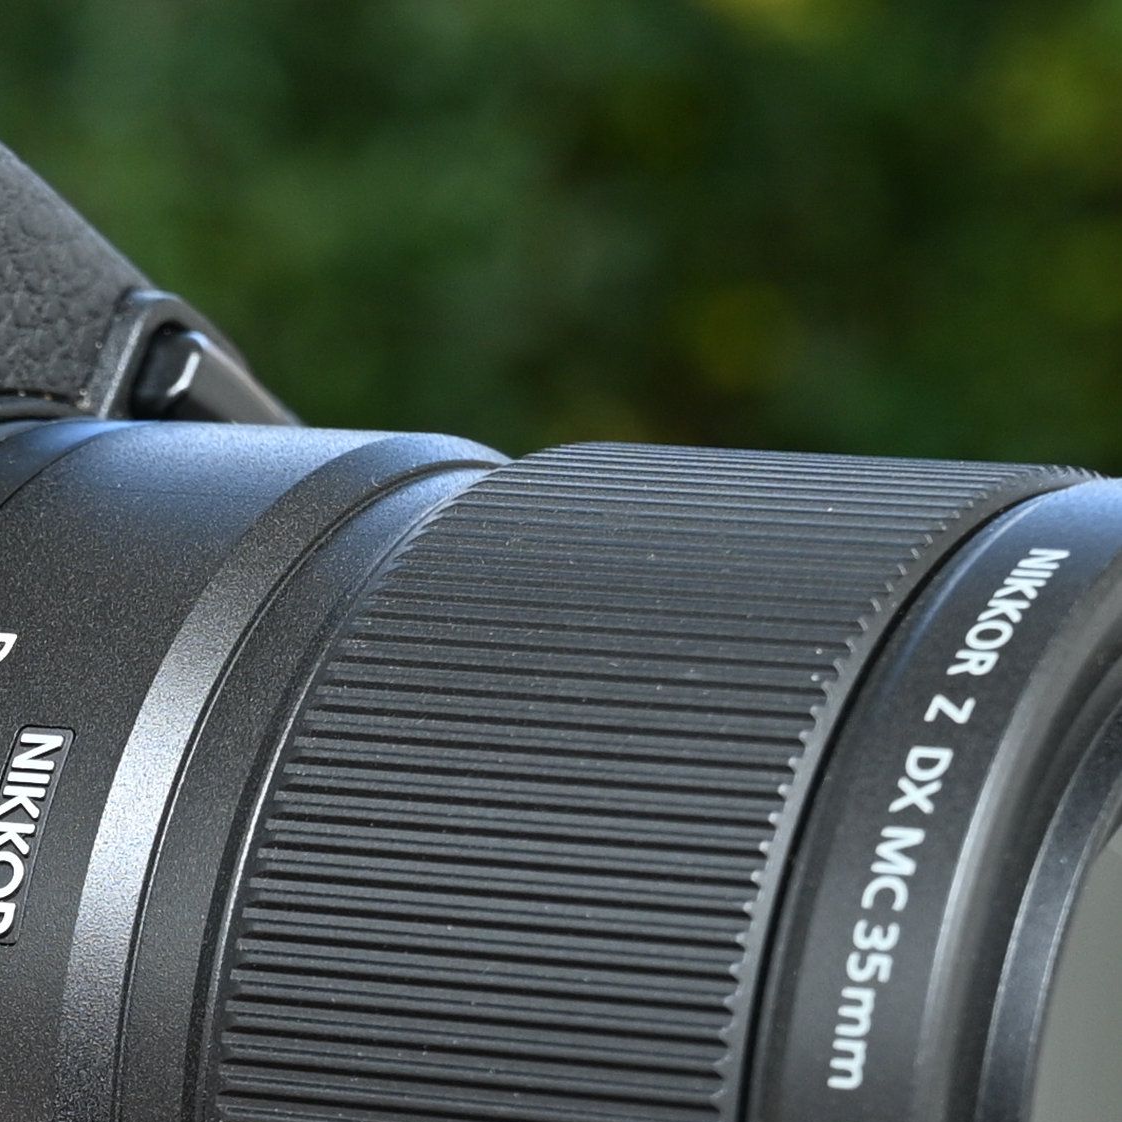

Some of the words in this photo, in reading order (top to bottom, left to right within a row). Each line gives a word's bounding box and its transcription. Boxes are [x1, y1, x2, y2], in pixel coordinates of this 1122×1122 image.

[946, 548, 1071, 676] NIKKOR
[923, 694, 976, 725] Z
[888, 745, 954, 814] DX
[860, 826, 925, 912] MC
[827, 919, 901, 1091] 35mm
